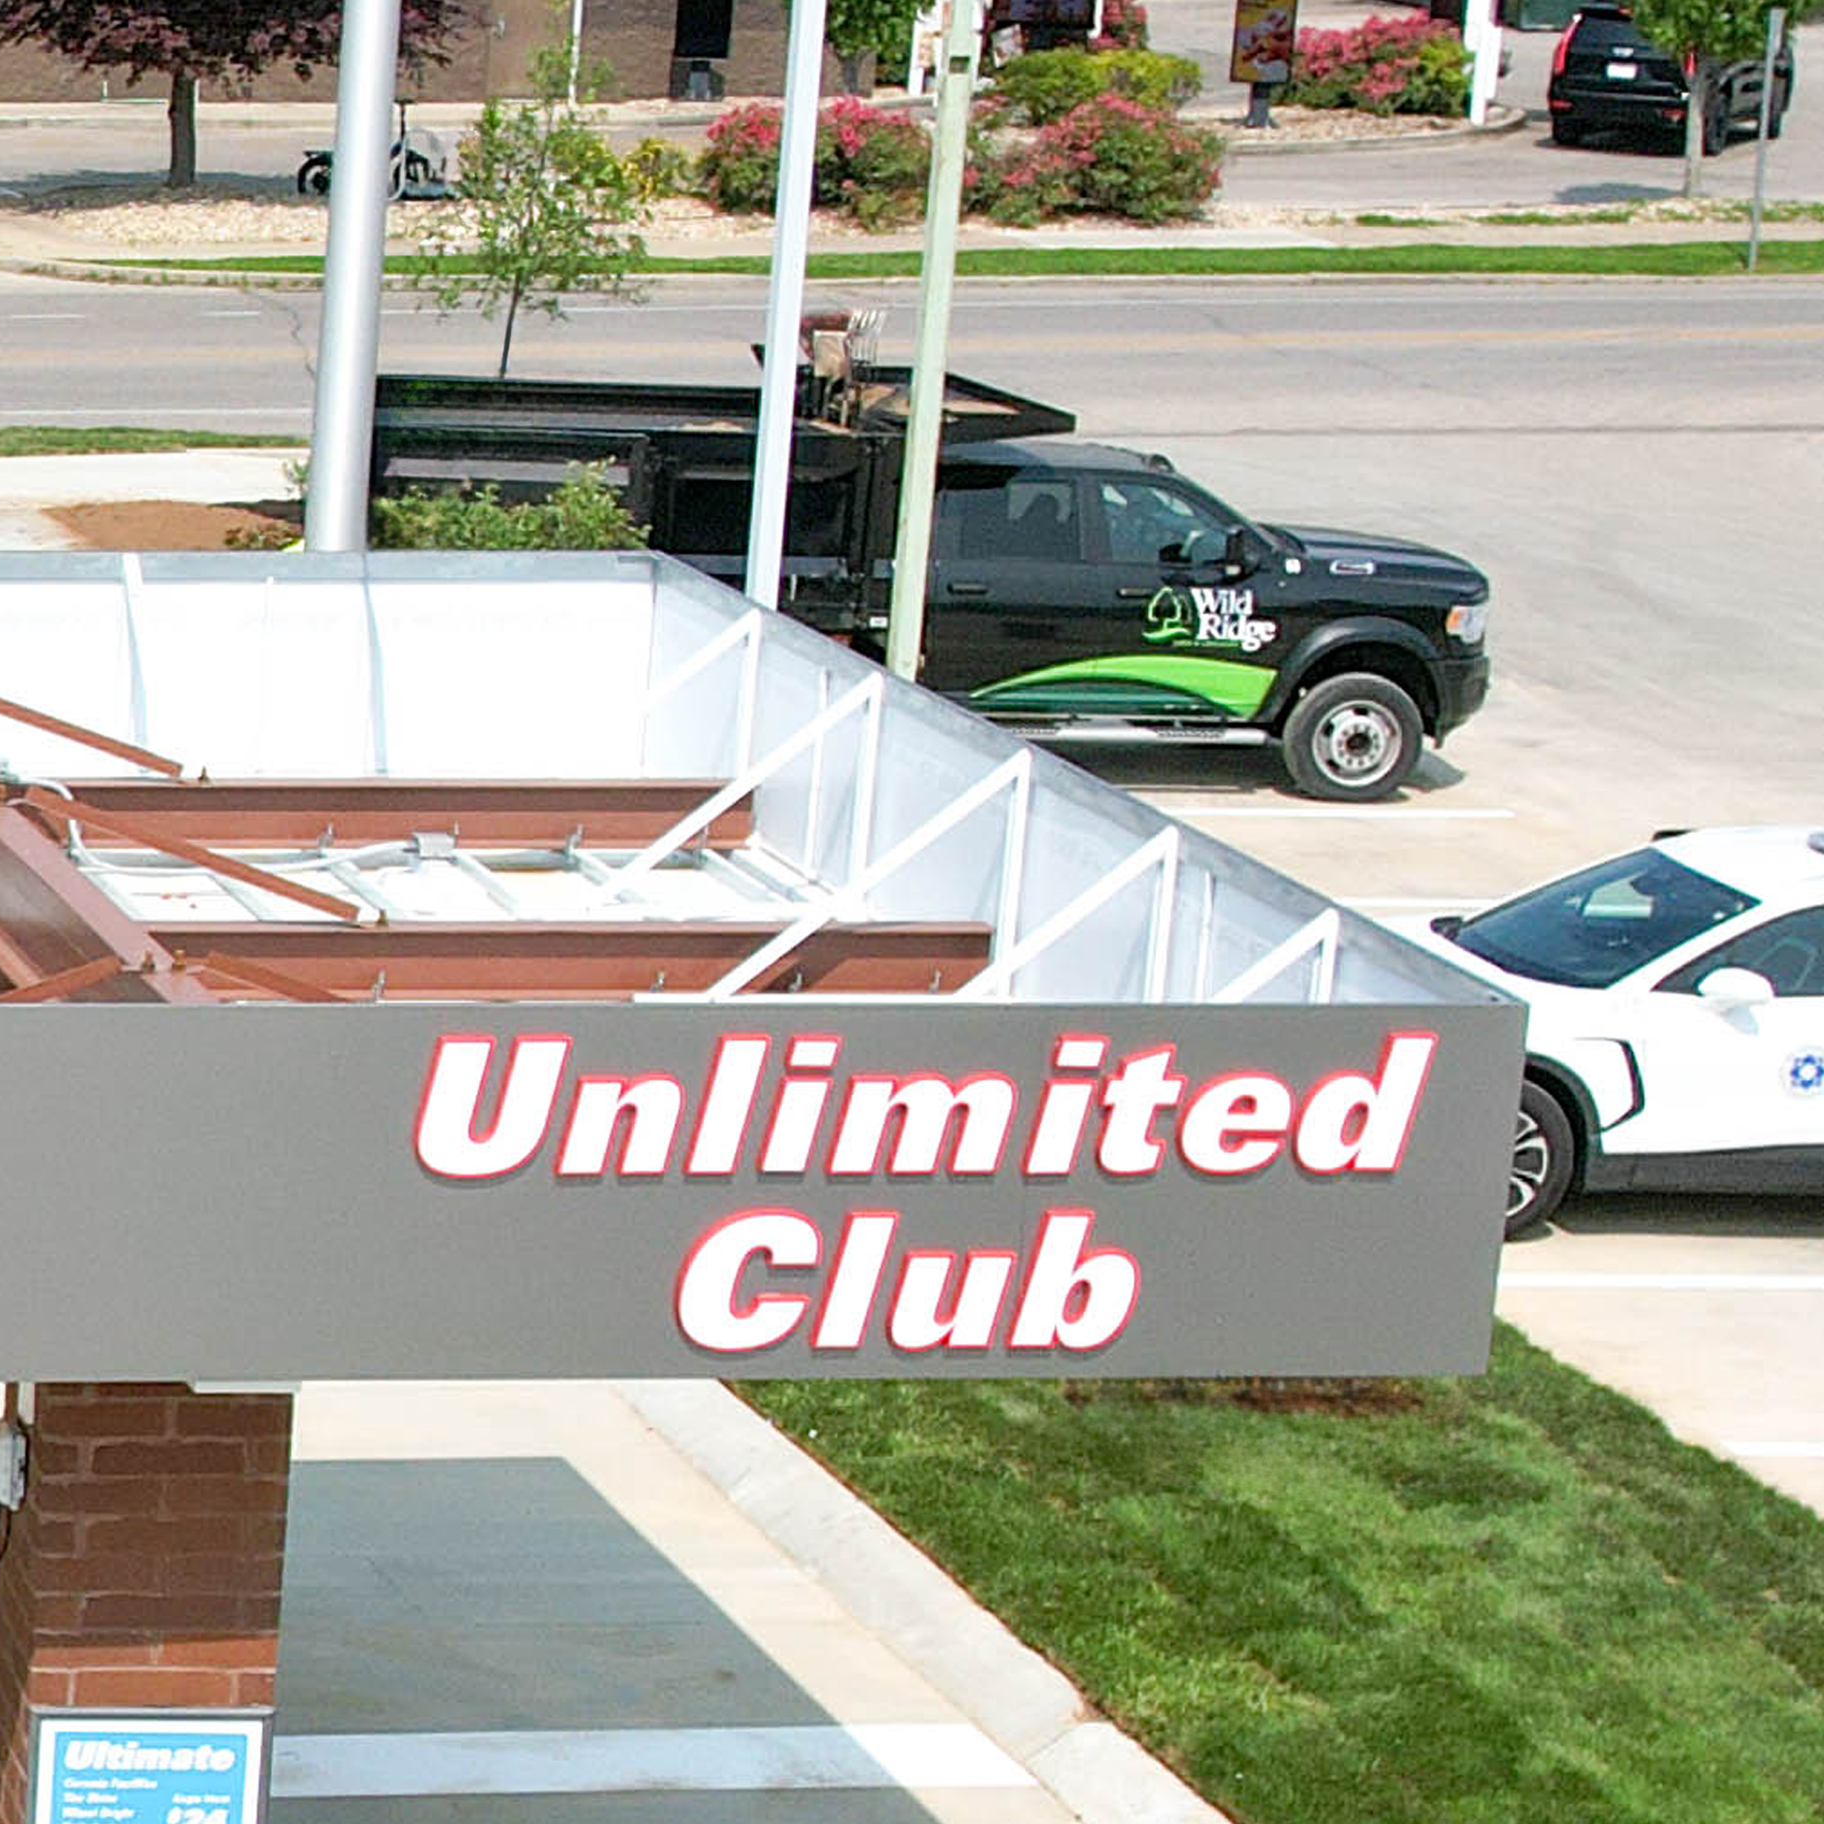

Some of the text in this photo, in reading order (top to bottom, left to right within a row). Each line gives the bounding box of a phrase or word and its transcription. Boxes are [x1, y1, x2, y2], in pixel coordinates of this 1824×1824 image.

[1190, 587, 1253, 614] Wild
[1196, 614, 1277, 652] Ridge
[414, 1034, 1439, 1180] Unlimited
[673, 1209, 1141, 1352] Club
[64, 1740, 235, 1771] Ultimate
